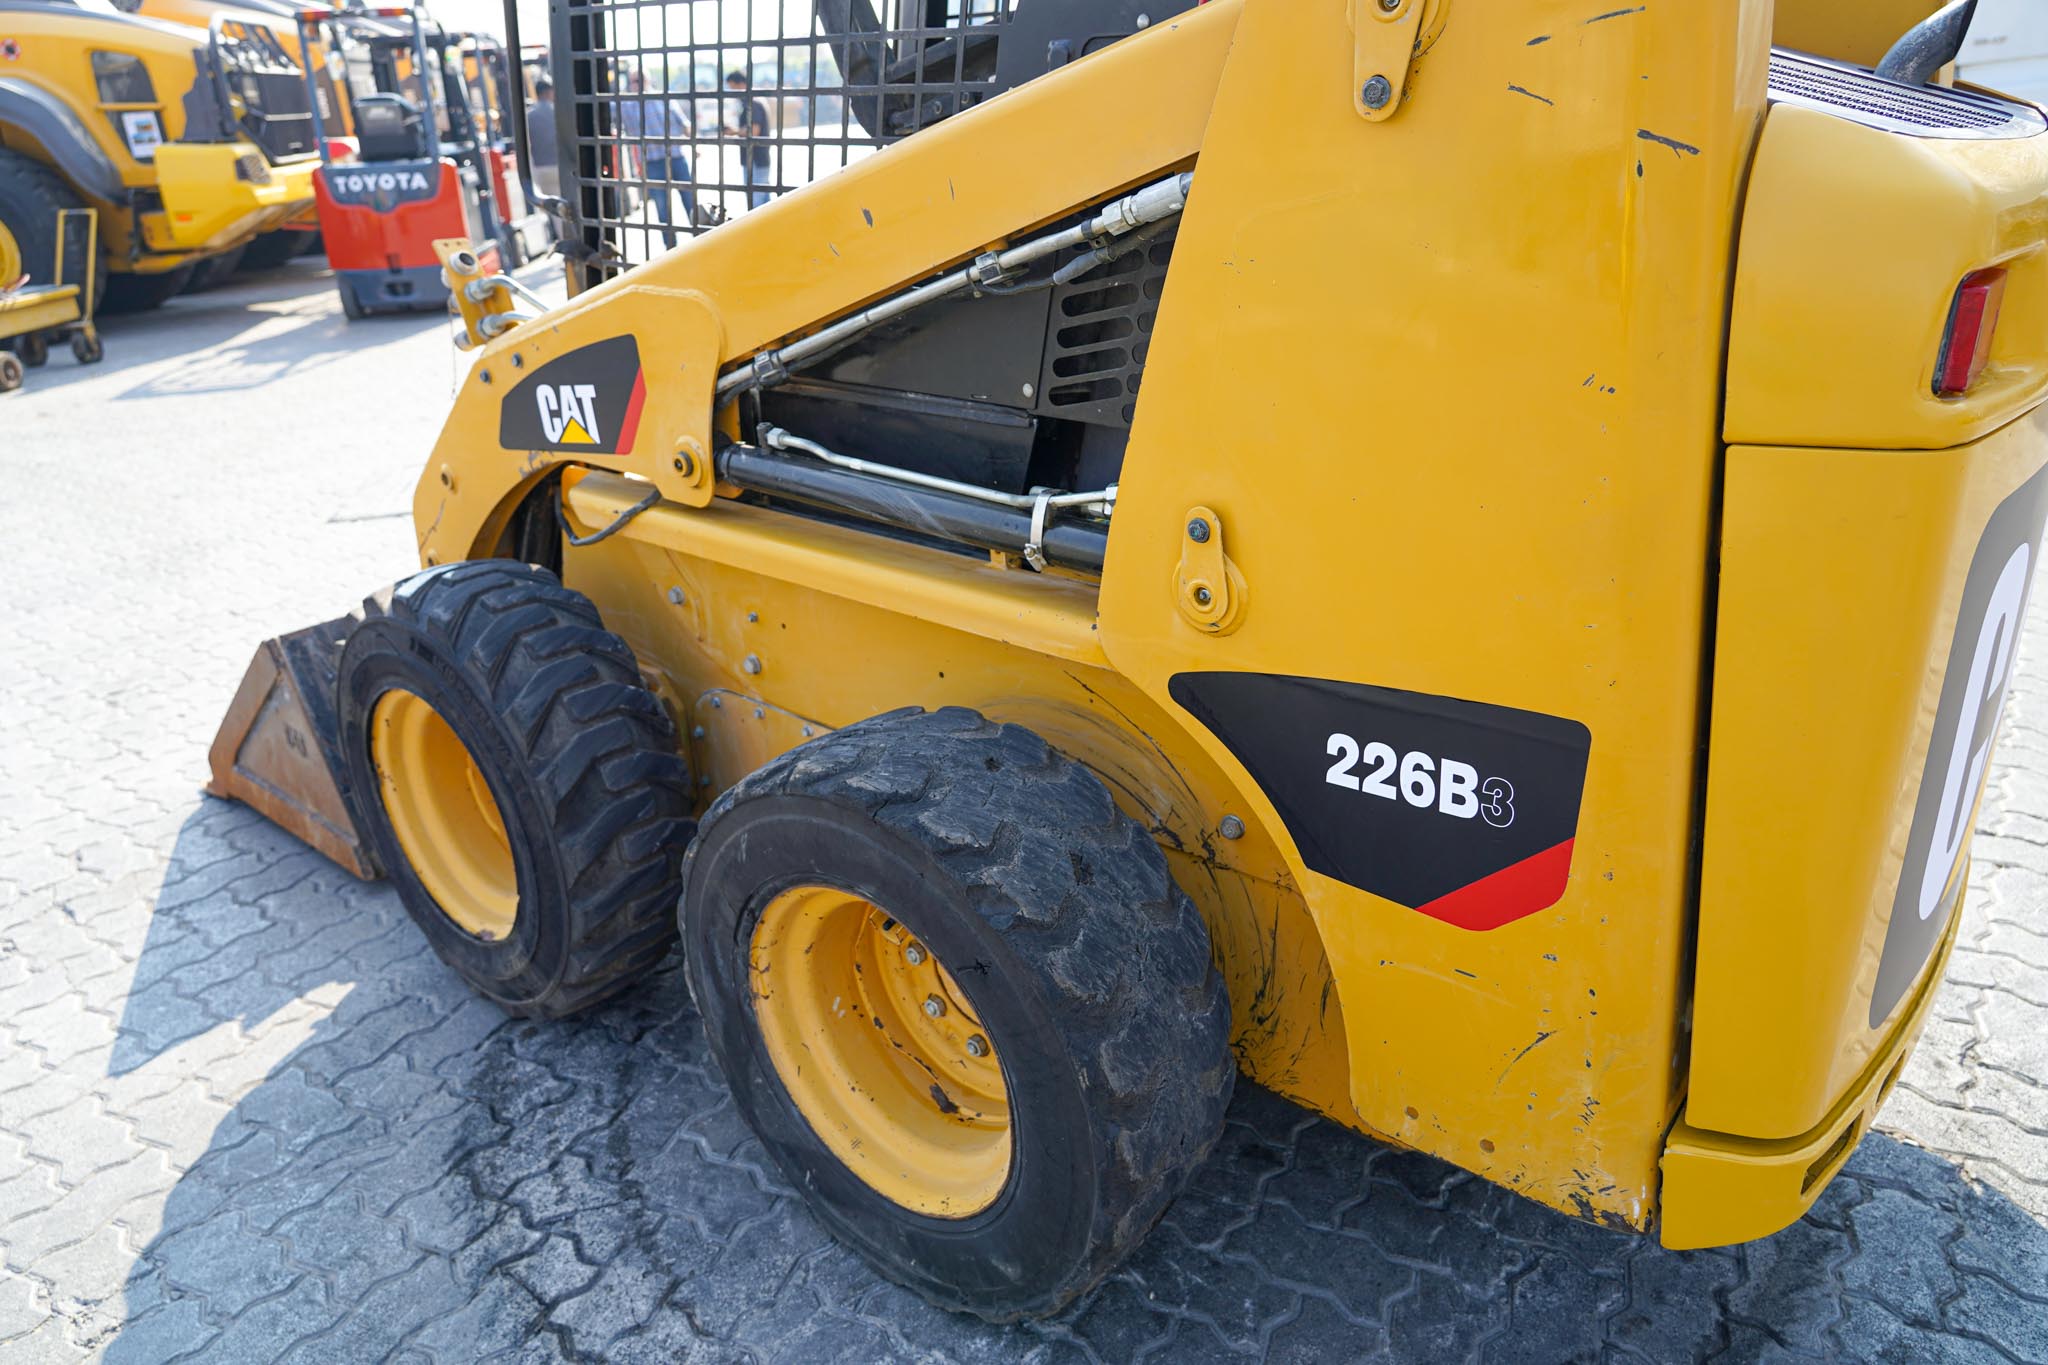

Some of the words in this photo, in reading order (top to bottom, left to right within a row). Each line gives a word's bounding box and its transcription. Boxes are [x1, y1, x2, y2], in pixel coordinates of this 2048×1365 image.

[333, 172, 429, 193] TOYOTA
[536, 384, 601, 444] CAT
[1325, 733, 1515, 828] 226B3
